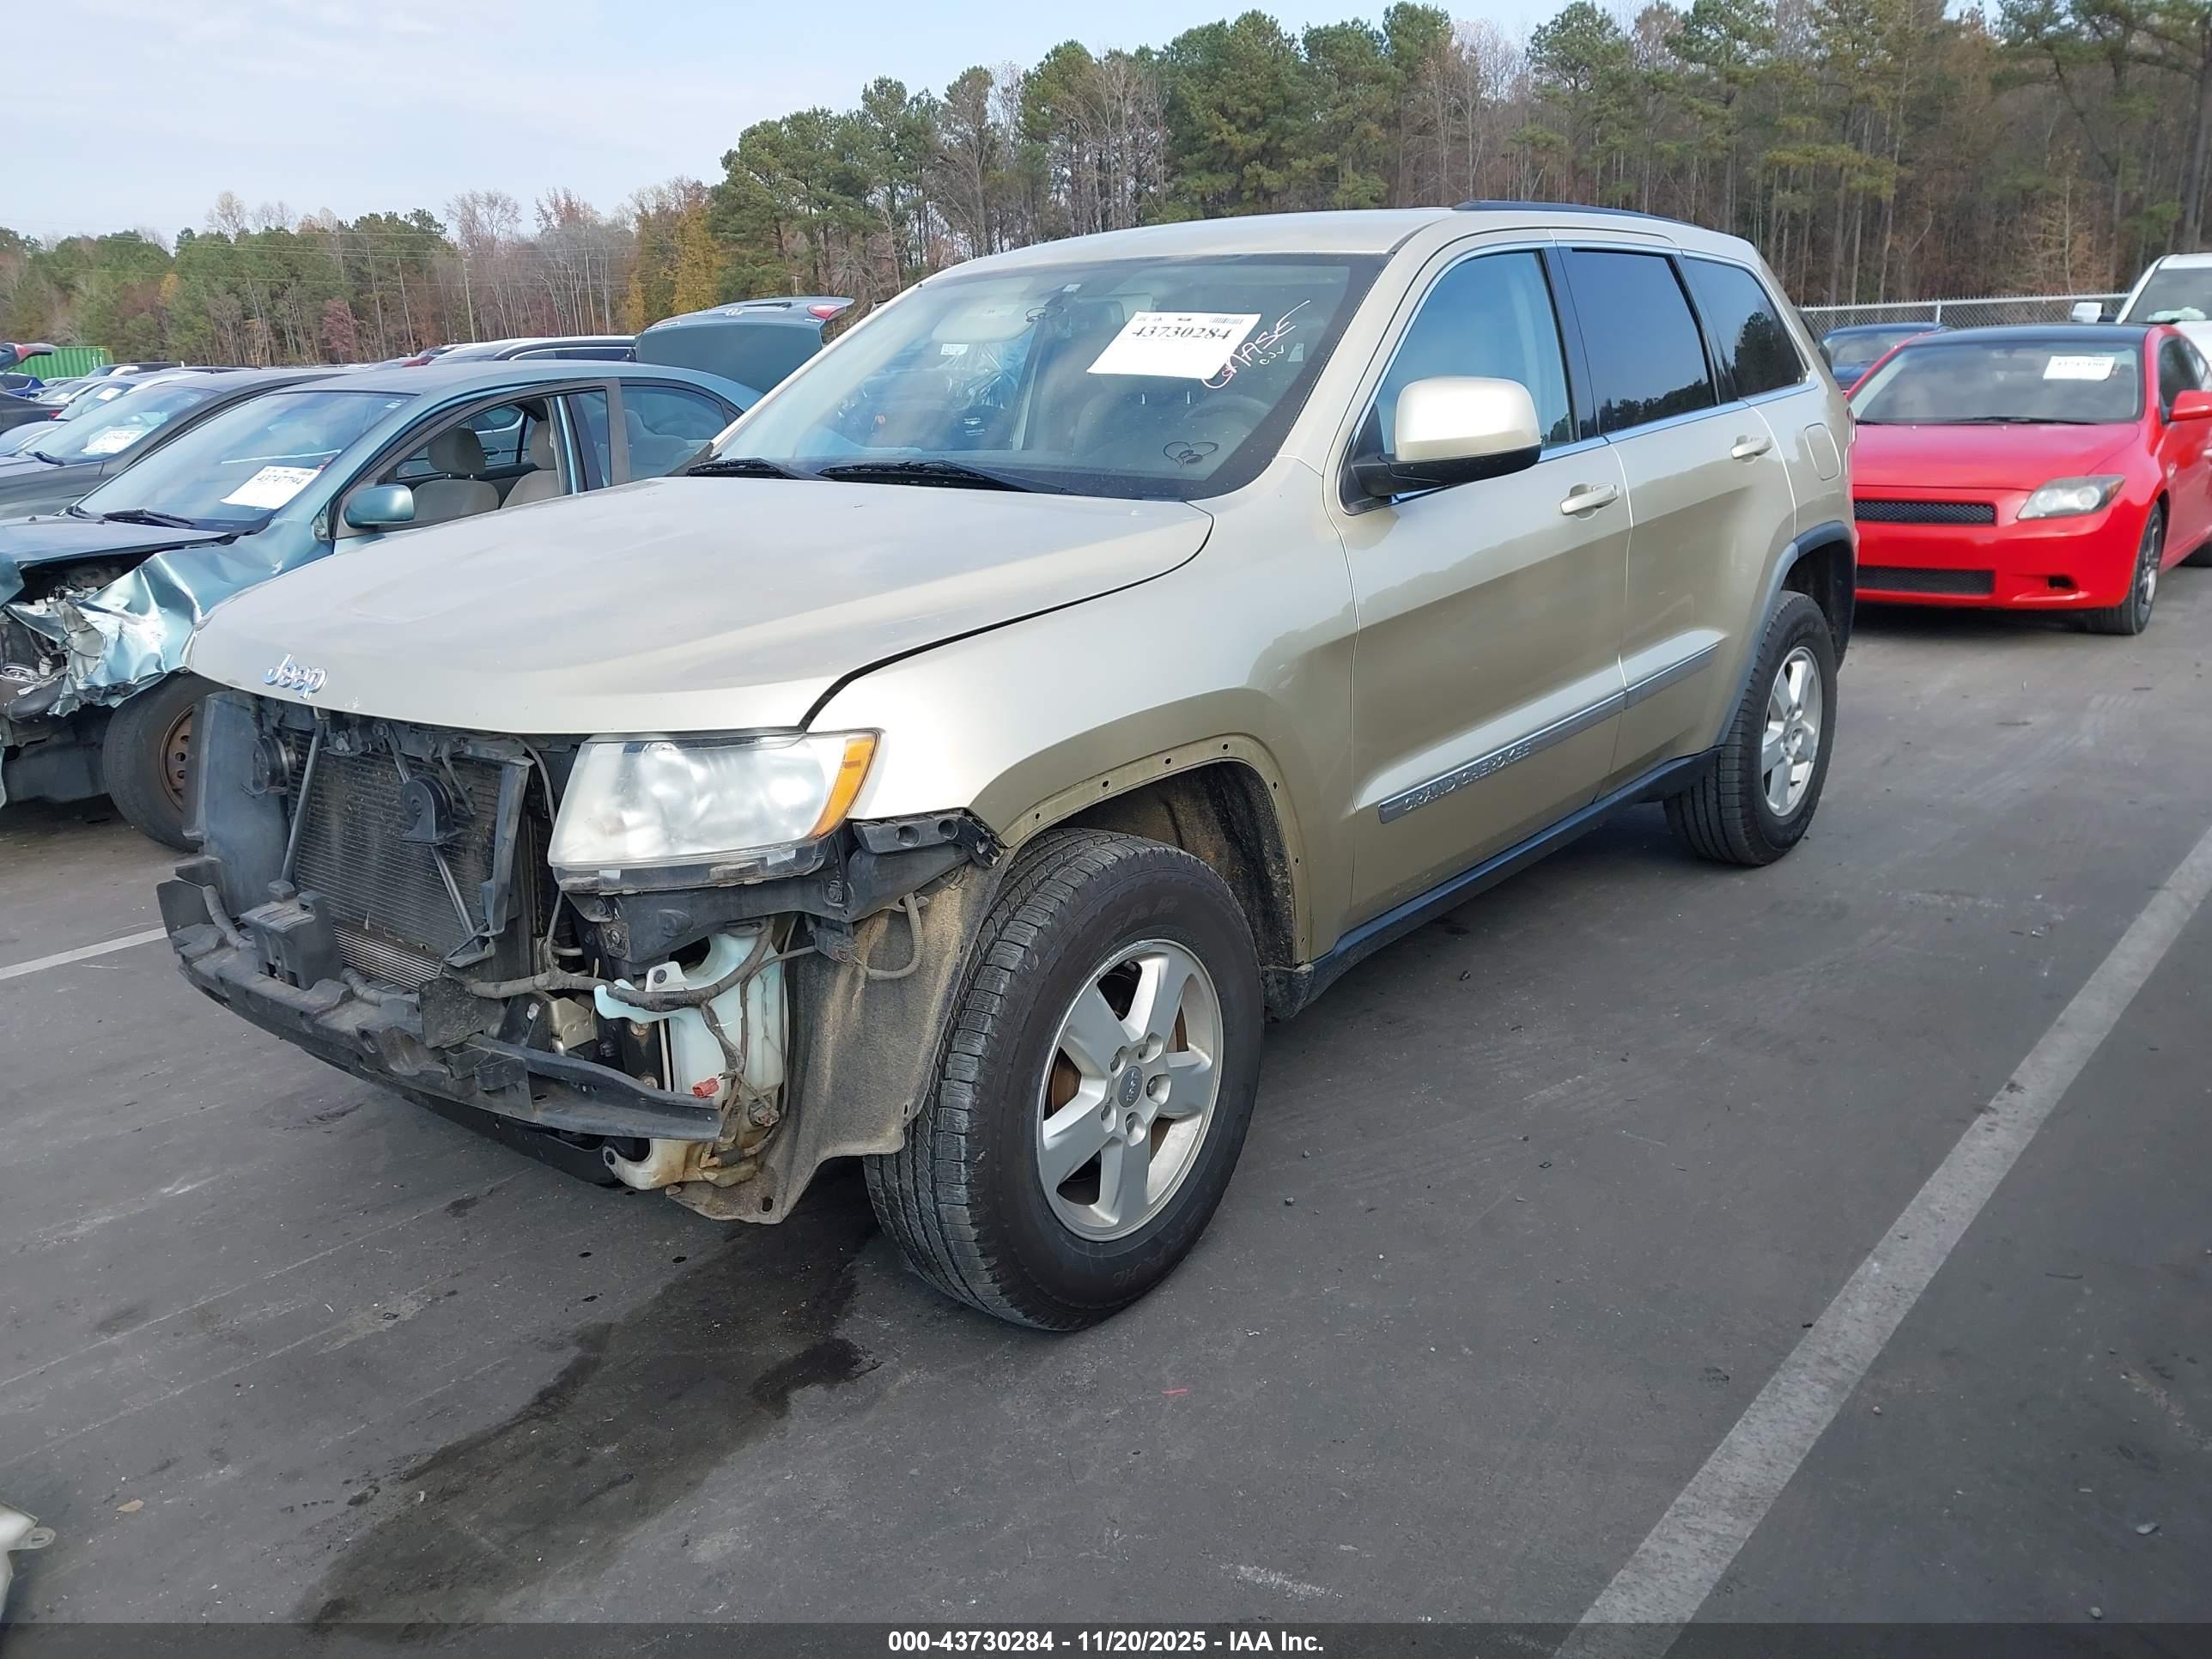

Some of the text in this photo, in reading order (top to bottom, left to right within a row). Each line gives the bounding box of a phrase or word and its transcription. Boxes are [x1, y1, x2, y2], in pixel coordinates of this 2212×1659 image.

[1132, 325, 1232, 340] 43730284
[262, 653, 328, 700] Jeep
[1404, 741, 1533, 811] GRAND CHEROKEE
[1126, 1071, 1139, 1103] Jeep
